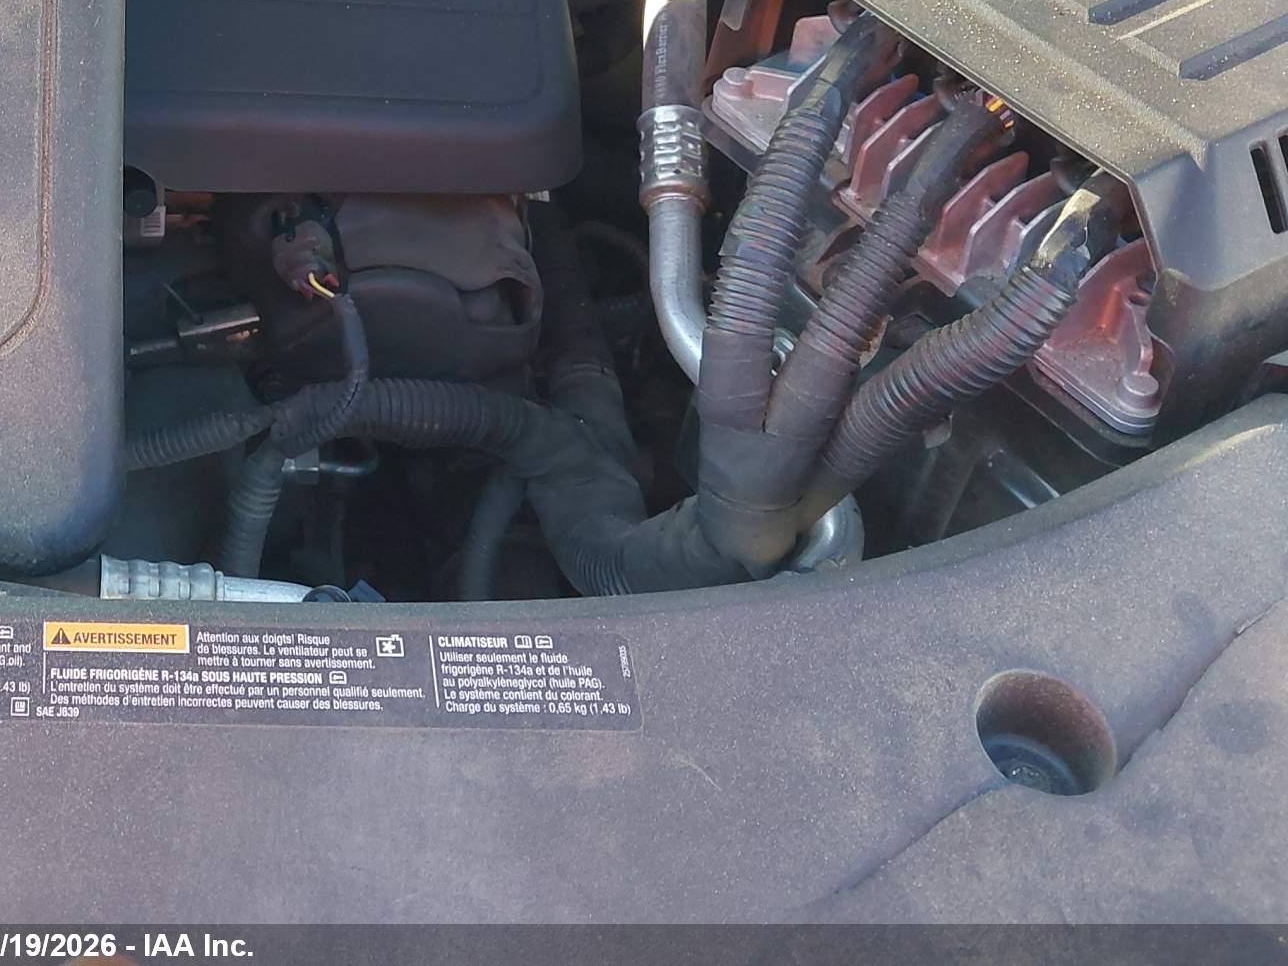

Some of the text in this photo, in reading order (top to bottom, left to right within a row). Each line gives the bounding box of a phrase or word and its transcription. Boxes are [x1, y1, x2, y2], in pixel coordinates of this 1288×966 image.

[73, 633, 177, 645] AVERTISSEMENT
[197, 632, 239, 644] Attention
[298, 635, 330, 645] Risque
[438, 637, 508, 648] CLIMATISEUR
[13, 643, 31, 653] and
[197, 644, 367, 658] de blessures. Le ventilateur peut se
[8, 656, 25, 667] oil).
[198, 656, 375, 669] mettre à tourner sans avertissement.
[440, 652, 568, 663] Utiliser seulement le fluide
[51, 668, 87, 680] FLUIDE
[161, 671, 199, 682] R-134a
[202, 671, 230, 682] SOUS
[233, 672, 267, 683] HAUTE
[269, 672, 322, 684] PRESSION
[441, 664, 494, 677] frigorigène
[496, 665, 533, 676] R-134a
[536, 666, 546, 675] et
[548, 666, 560, 676] de
[443, 678, 455, 687] au
[458, 677, 546, 689] polyalkylèneglycol
[549, 678, 576, 689] (huile
[50, 682, 426, 699] L'entretien du système doit être effectué par un personnel qualifié seulement.
[444, 689, 603, 701] Le système contient du colorant.
[50, 694, 383, 711] Des méthodes d'entretien incorrectes peuvent causer des blessures.
[446, 701, 481, 714] Charge
[484, 702, 496, 712] du
[499, 702, 540, 715] système
[574, 703, 587, 715] kg
[618, 704, 631, 715] lb)
[36, 706, 79, 717] SAE J639
